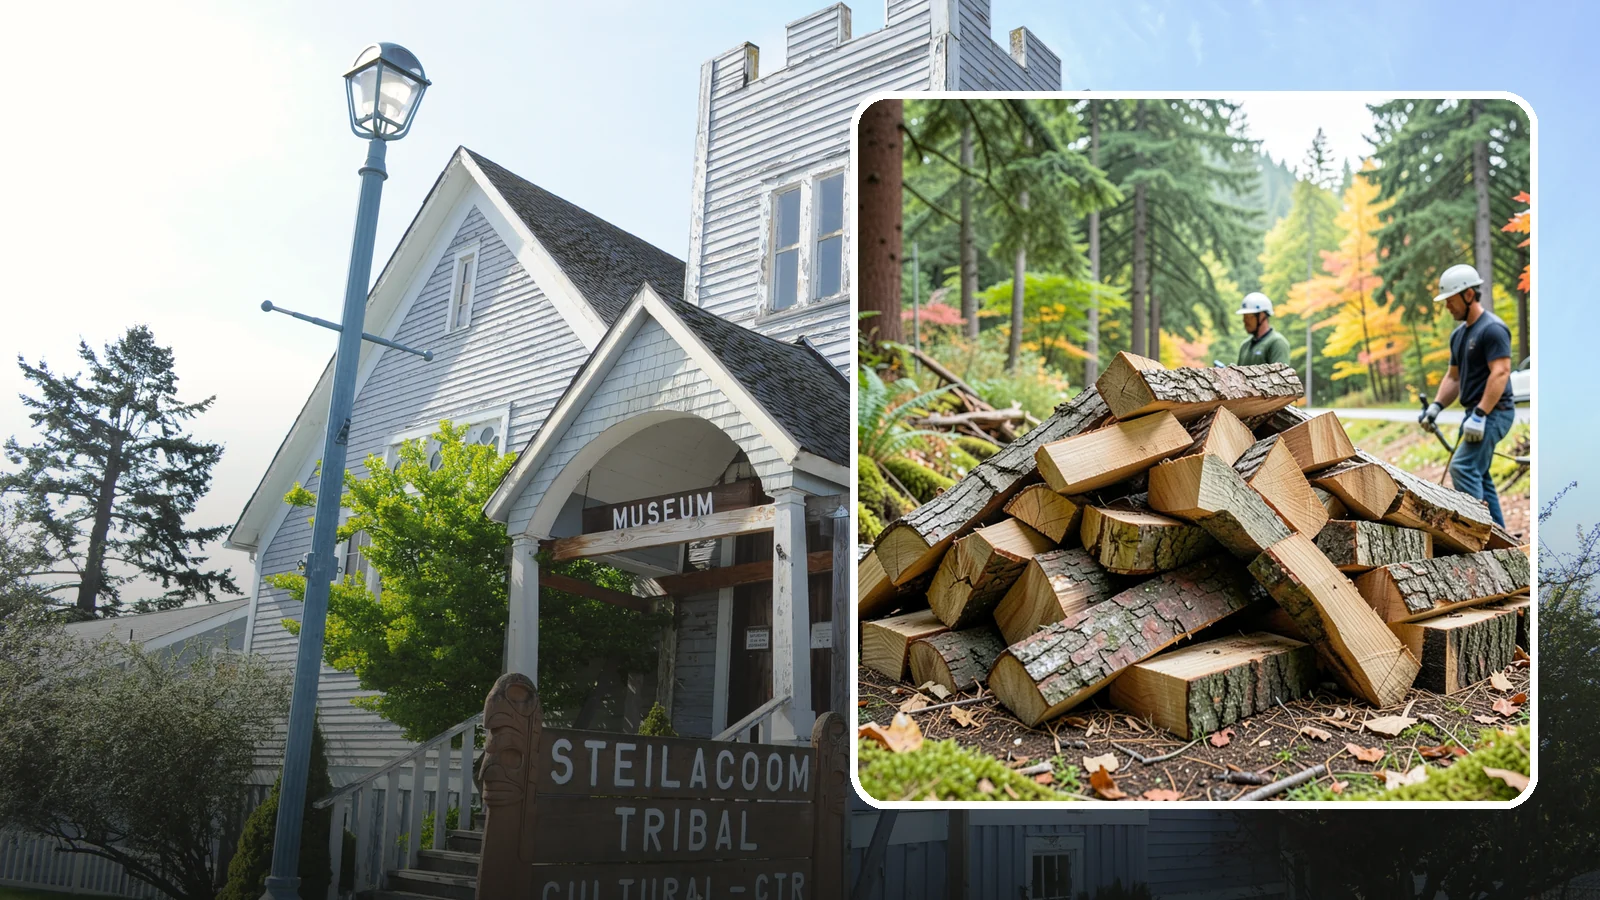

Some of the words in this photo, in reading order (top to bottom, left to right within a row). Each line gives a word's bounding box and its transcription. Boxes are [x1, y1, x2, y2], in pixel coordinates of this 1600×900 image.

[613, 491, 713, 530] MUSEUM
[551, 739, 809, 792] STEILACOOM
[615, 807, 757, 851] TRIBAL
